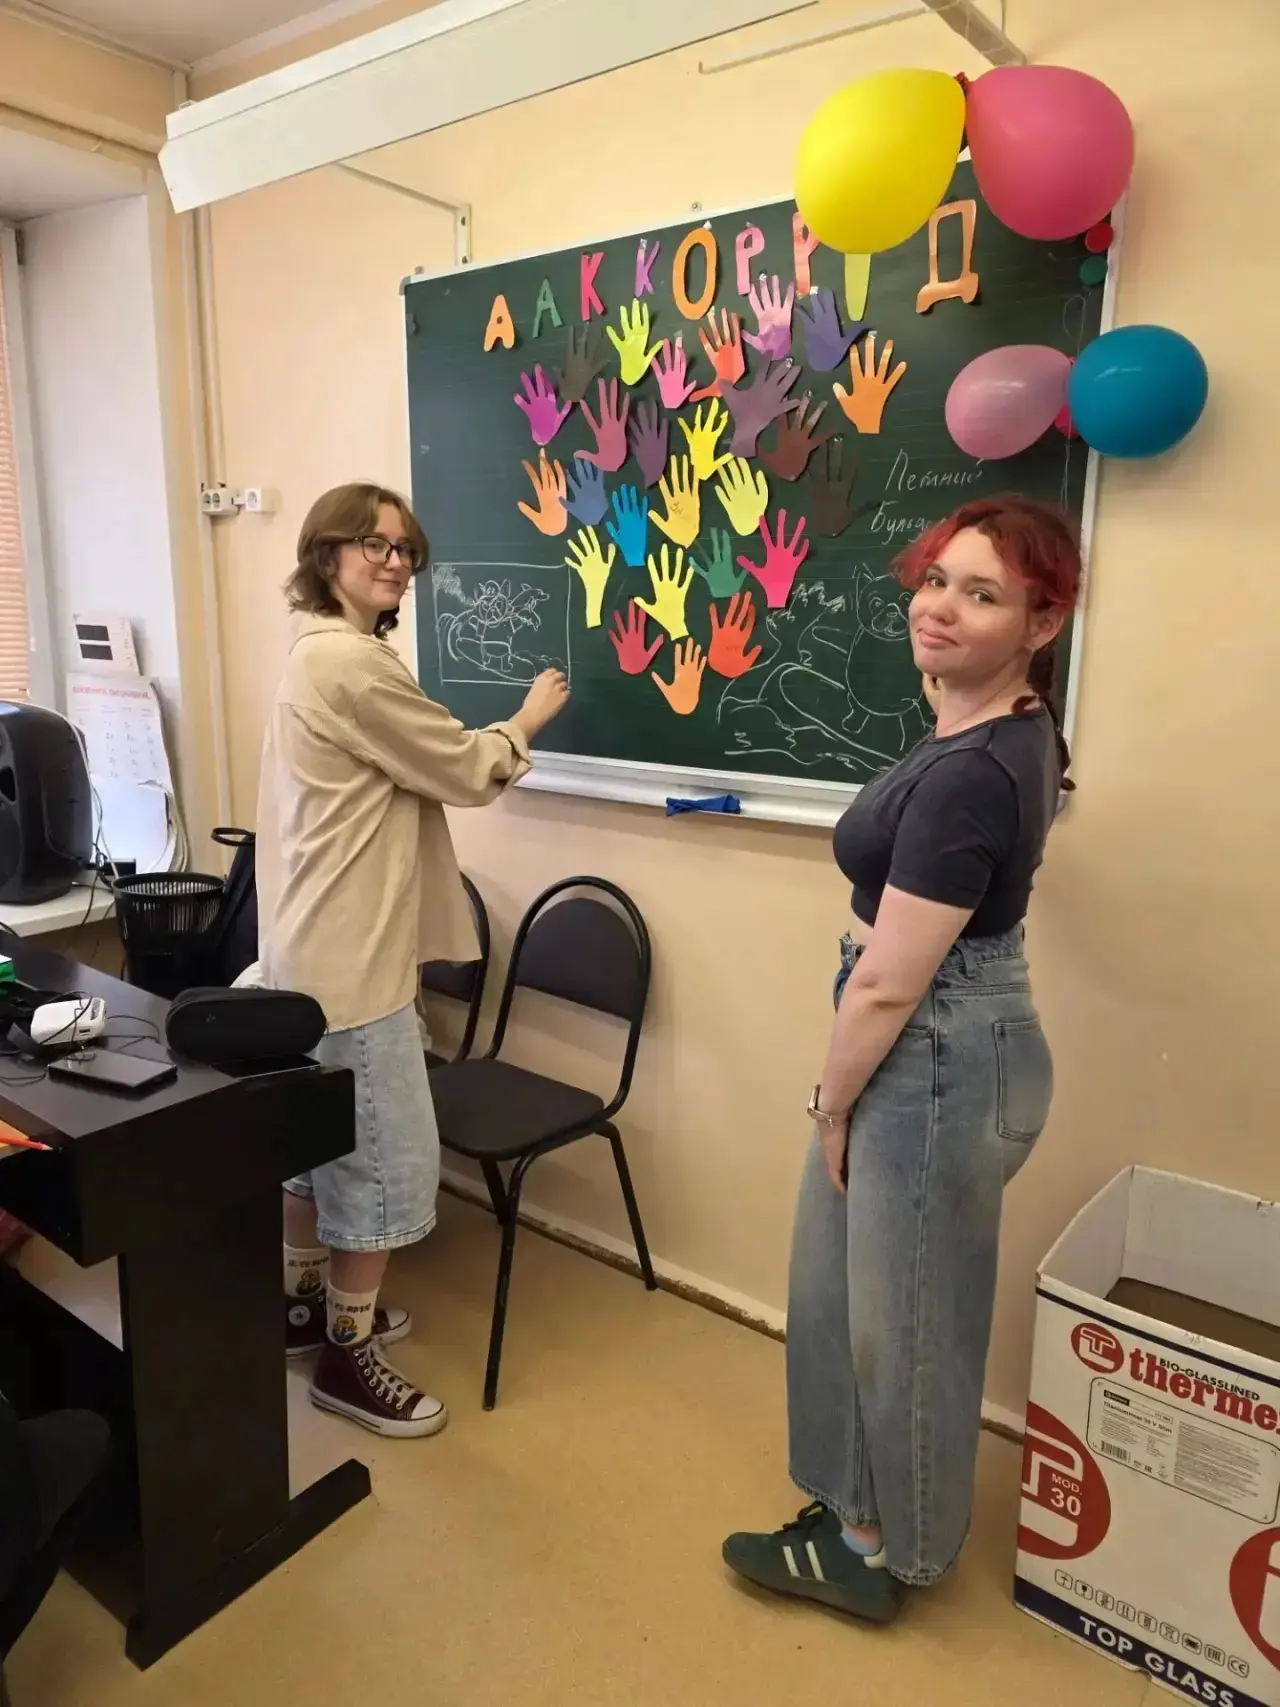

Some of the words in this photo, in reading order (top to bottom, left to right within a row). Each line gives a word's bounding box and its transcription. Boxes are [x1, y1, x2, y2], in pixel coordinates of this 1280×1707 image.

[1129, 1347, 1280, 1435] therme
[1159, 1358, 1260, 1401] BIO-GLASSLINED
[1050, 1487, 1081, 1516] 30
[1080, 1616, 1133, 1653] TOP
[1145, 1652, 1235, 1707] GLASS
